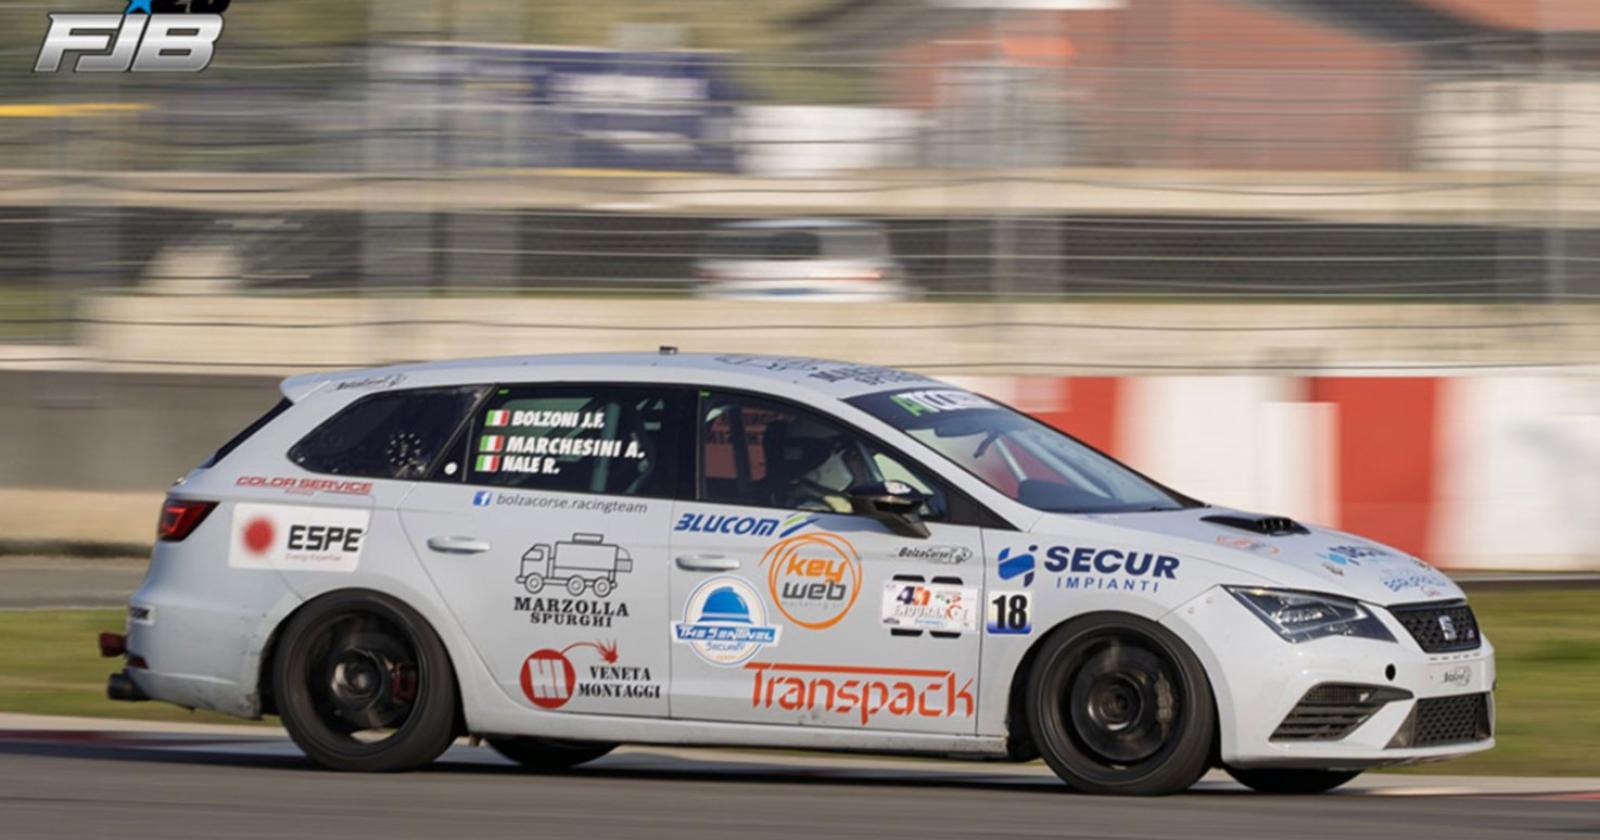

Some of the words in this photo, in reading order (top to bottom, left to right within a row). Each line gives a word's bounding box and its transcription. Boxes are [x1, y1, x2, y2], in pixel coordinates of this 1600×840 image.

[511, 410, 577, 427] BOLZONI
[581, 412, 605, 428] J.F.
[506, 436, 622, 457] MARCHESINI
[624, 441, 645, 458] A.
[502, 456, 539, 472] NALE
[542, 459, 560, 474] R.
[299, 479, 373, 495] SERVICE
[496, 494, 648, 514] bolzacorse.racingteam
[287, 524, 362, 552] ESPE
[785, 553, 848, 583] key
[1043, 545, 1180, 580] SECUR
[782, 580, 847, 601] web
[1056, 576, 1159, 592] IMPIANTI
[513, 596, 629, 617] MARZOLLA
[991, 594, 1028, 630] 18
[529, 612, 613, 628] SPURGHI
[589, 665, 652, 681] VENETA
[578, 682, 661, 699] MONTAGGI
[744, 660, 975, 726] Transpack
